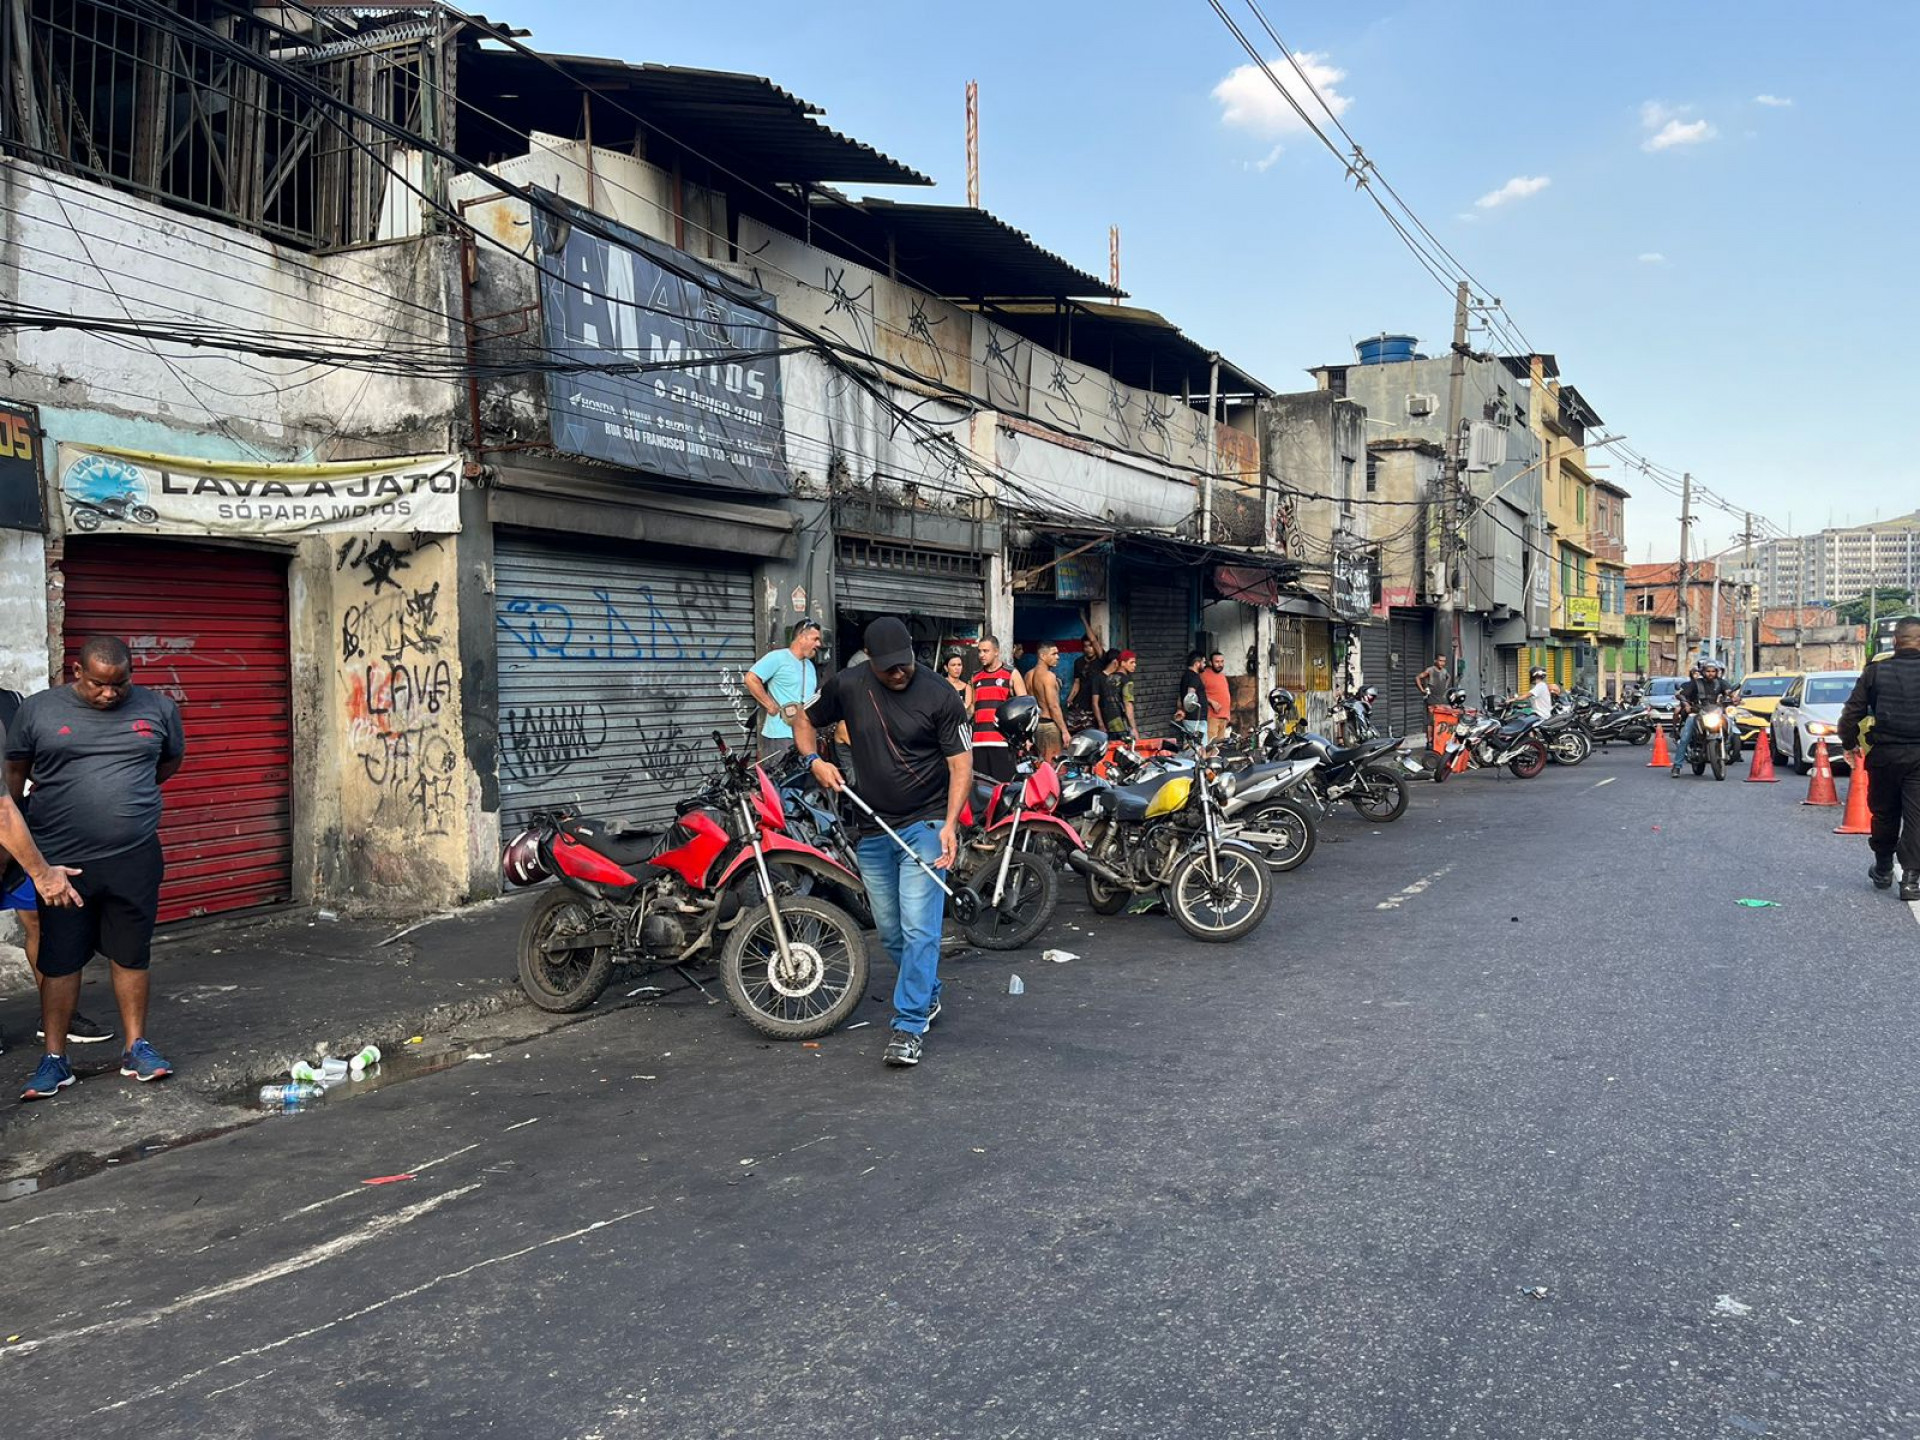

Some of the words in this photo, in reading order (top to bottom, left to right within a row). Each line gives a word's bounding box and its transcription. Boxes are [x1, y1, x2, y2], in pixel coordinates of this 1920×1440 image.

[650, 333, 765, 400] MOTOS
[605, 422, 621, 438] RUA
[624, 425, 641, 442] SÃO
[642, 431, 685, 451] FRANCISCO
[162, 471, 293, 498] LAVA
[304, 480, 336, 498] A
[347, 471, 457, 498] JATO
[218, 500, 251, 519] SÓ
[260, 504, 325, 520] PARA
[332, 500, 411, 520] MOTOS
[366, 660, 451, 714] LAVA
[358, 723, 455, 785] JATO
